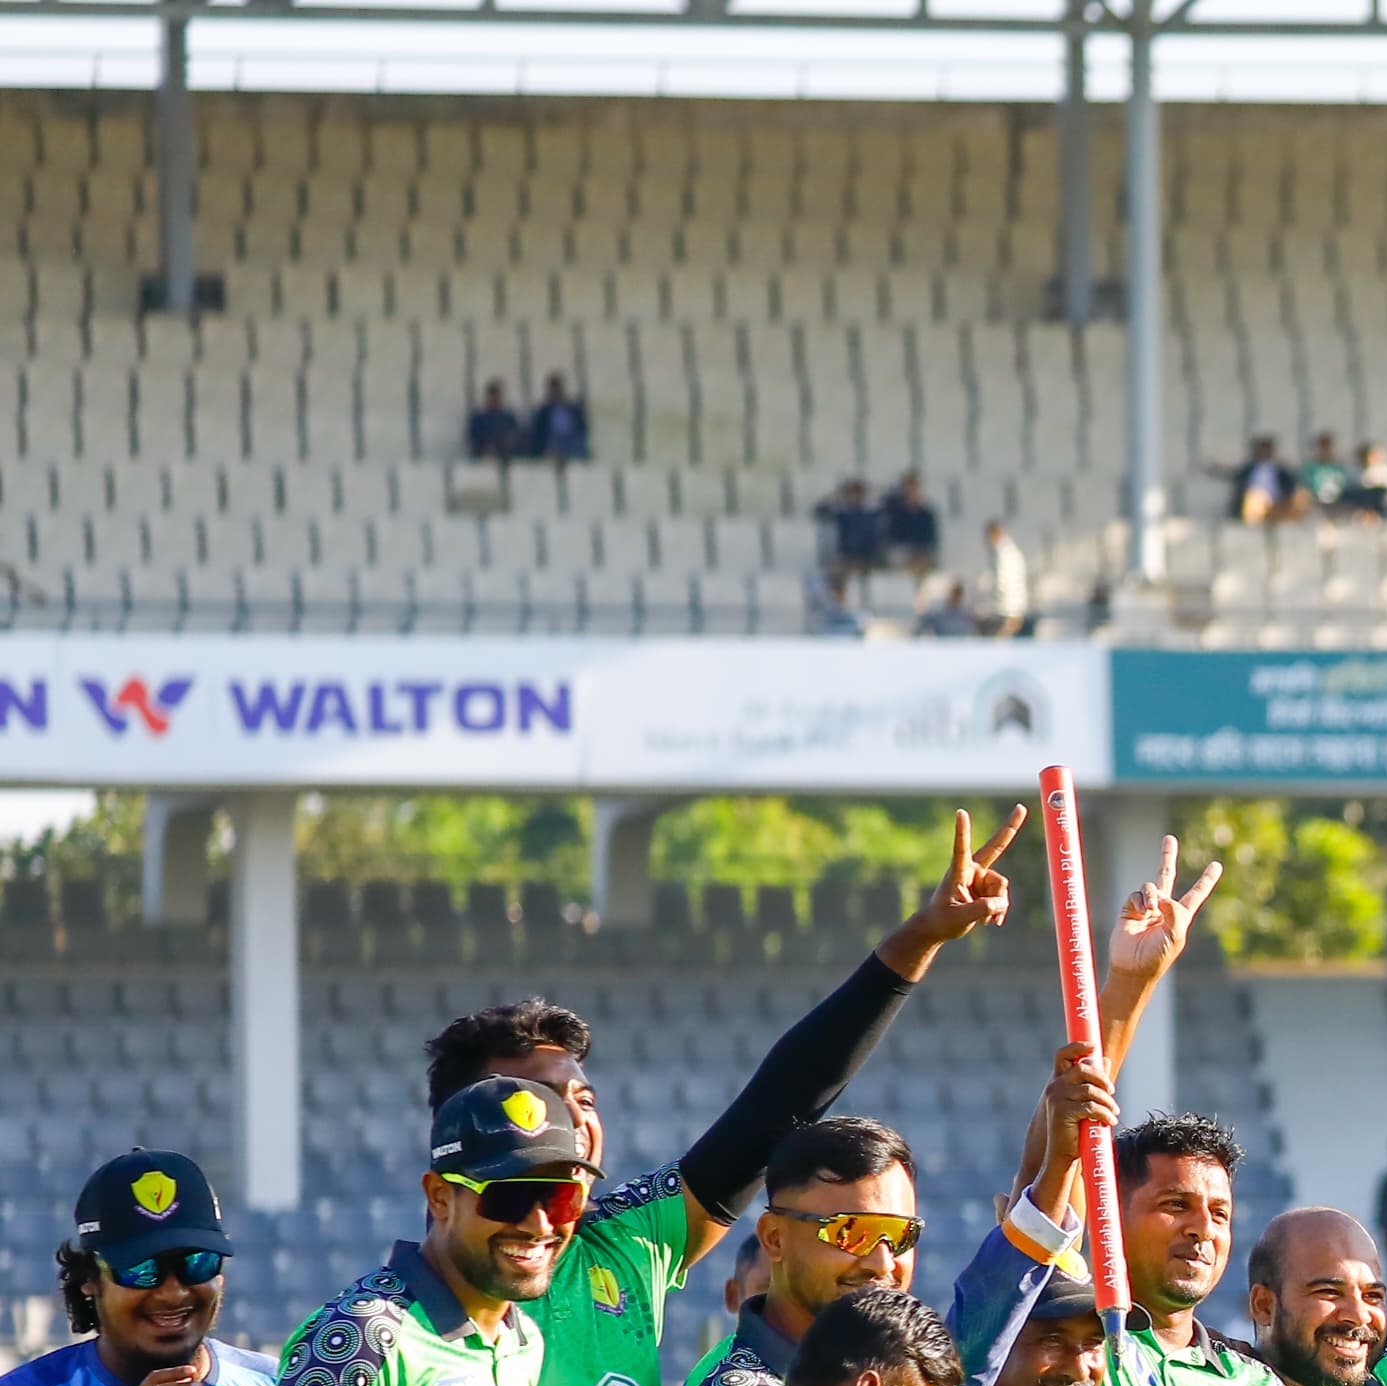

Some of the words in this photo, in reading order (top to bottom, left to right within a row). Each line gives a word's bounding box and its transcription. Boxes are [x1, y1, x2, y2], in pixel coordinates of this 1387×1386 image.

[230, 680, 573, 733] WALTON
[1063, 875, 1079, 911] Bank
[1092, 1143, 1108, 1178] Bank
[1094, 1181, 1112, 1220] Islami
